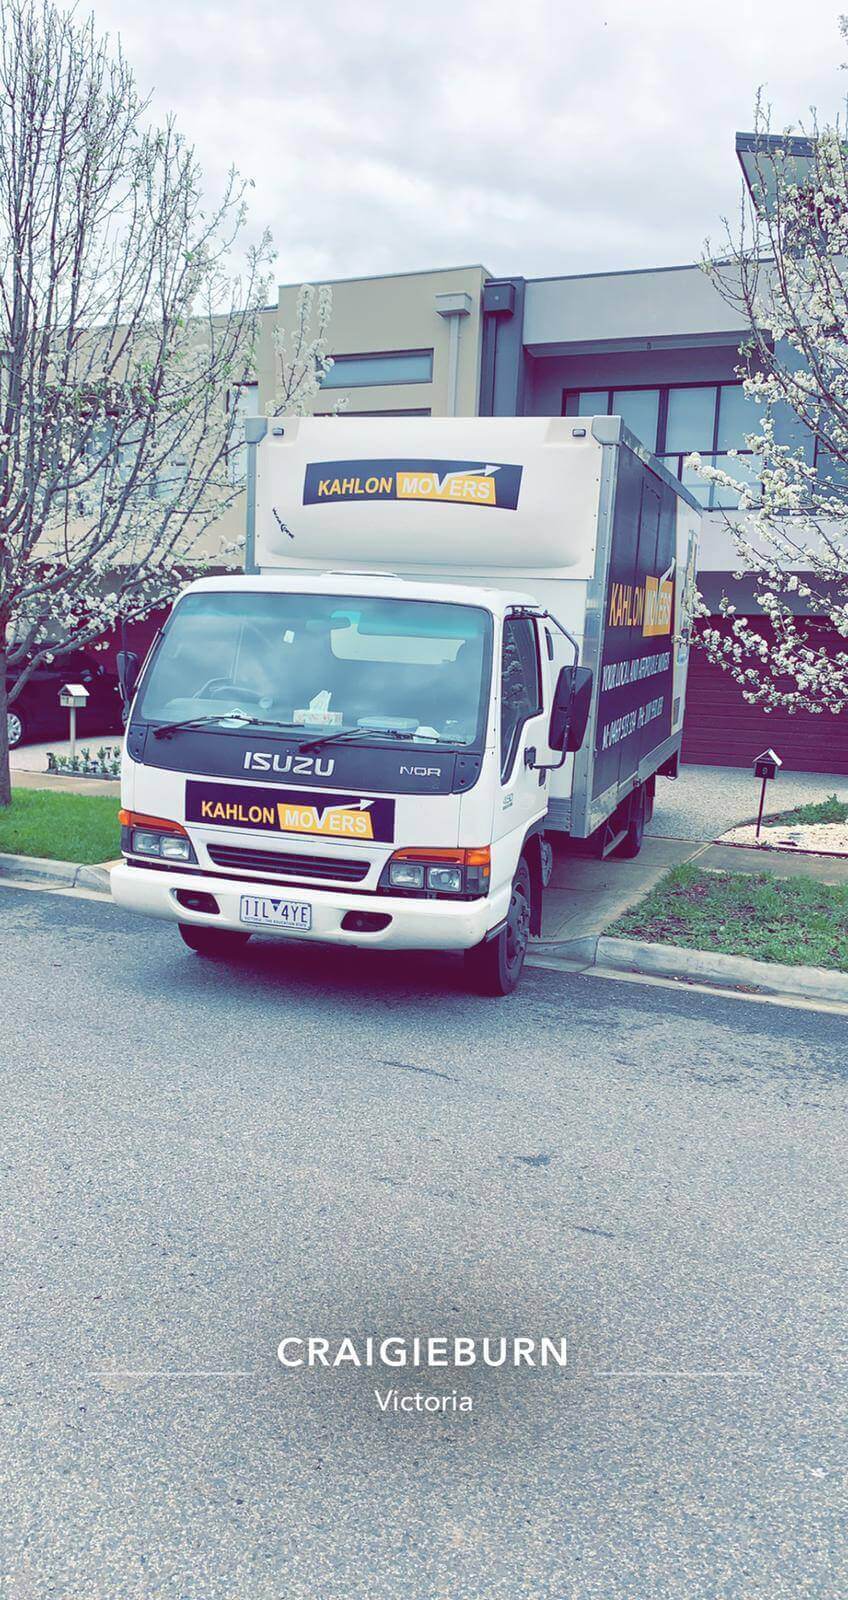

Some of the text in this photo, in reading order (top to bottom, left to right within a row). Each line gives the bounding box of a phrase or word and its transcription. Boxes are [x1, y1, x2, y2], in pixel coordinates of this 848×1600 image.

[318, 472, 490, 499] KAHLON MOVERS
[609, 579, 672, 626] KAHLON MOVERS
[243, 751, 441, 777] ISUZU NQR
[201, 801, 367, 834] KAHLON MOVERS
[281, 904, 308, 923] 4YE
